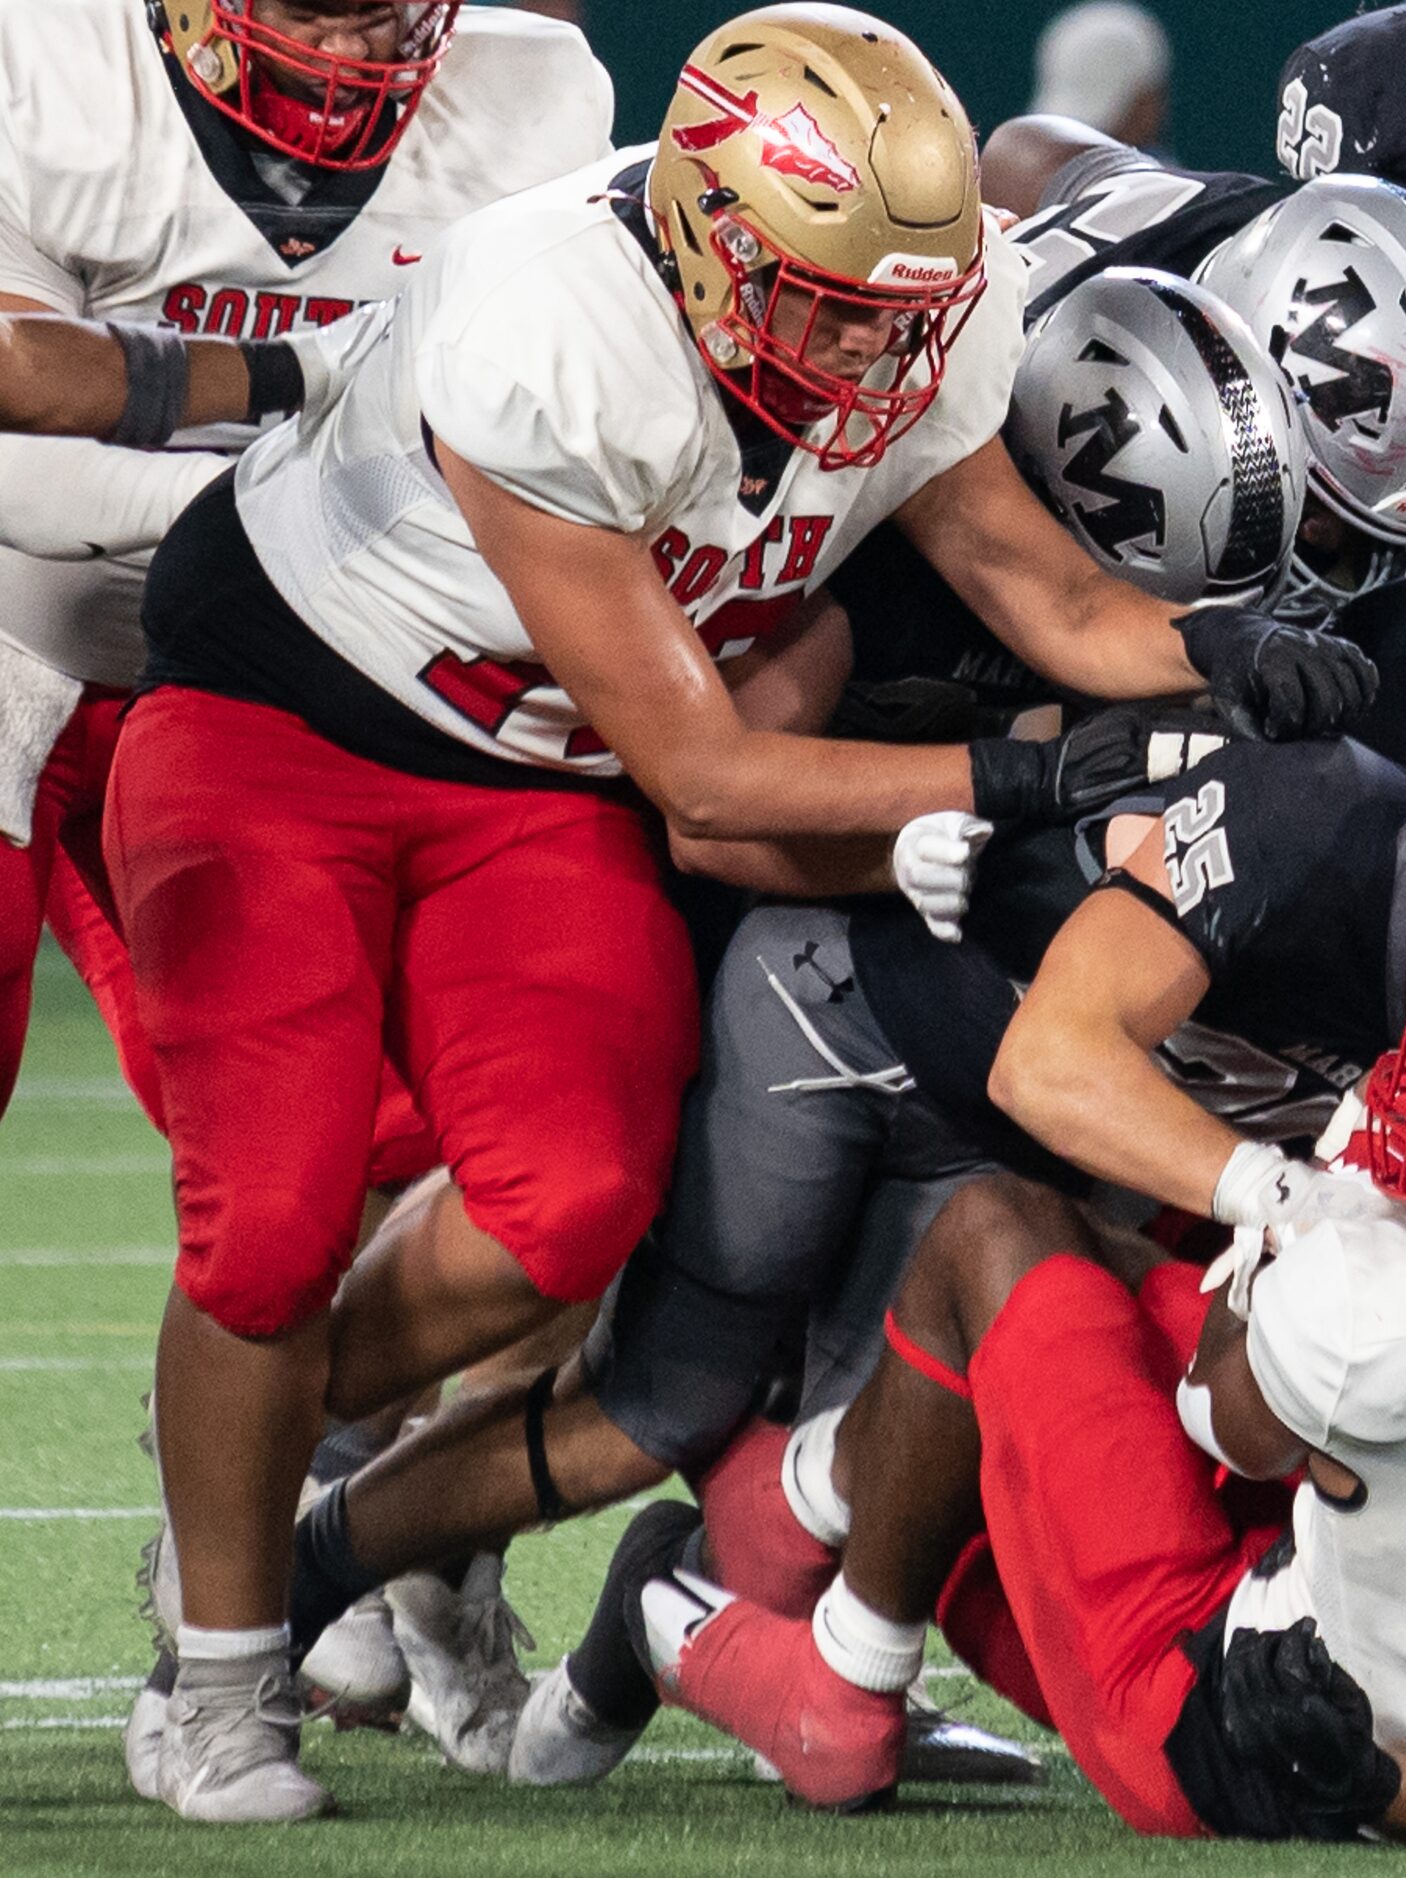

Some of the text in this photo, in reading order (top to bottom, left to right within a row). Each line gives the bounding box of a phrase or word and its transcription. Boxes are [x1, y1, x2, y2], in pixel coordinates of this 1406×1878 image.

[1277, 78, 1343, 180] 22
[650, 515, 834, 605] SOTH
[1163, 780, 1236, 918] 25
